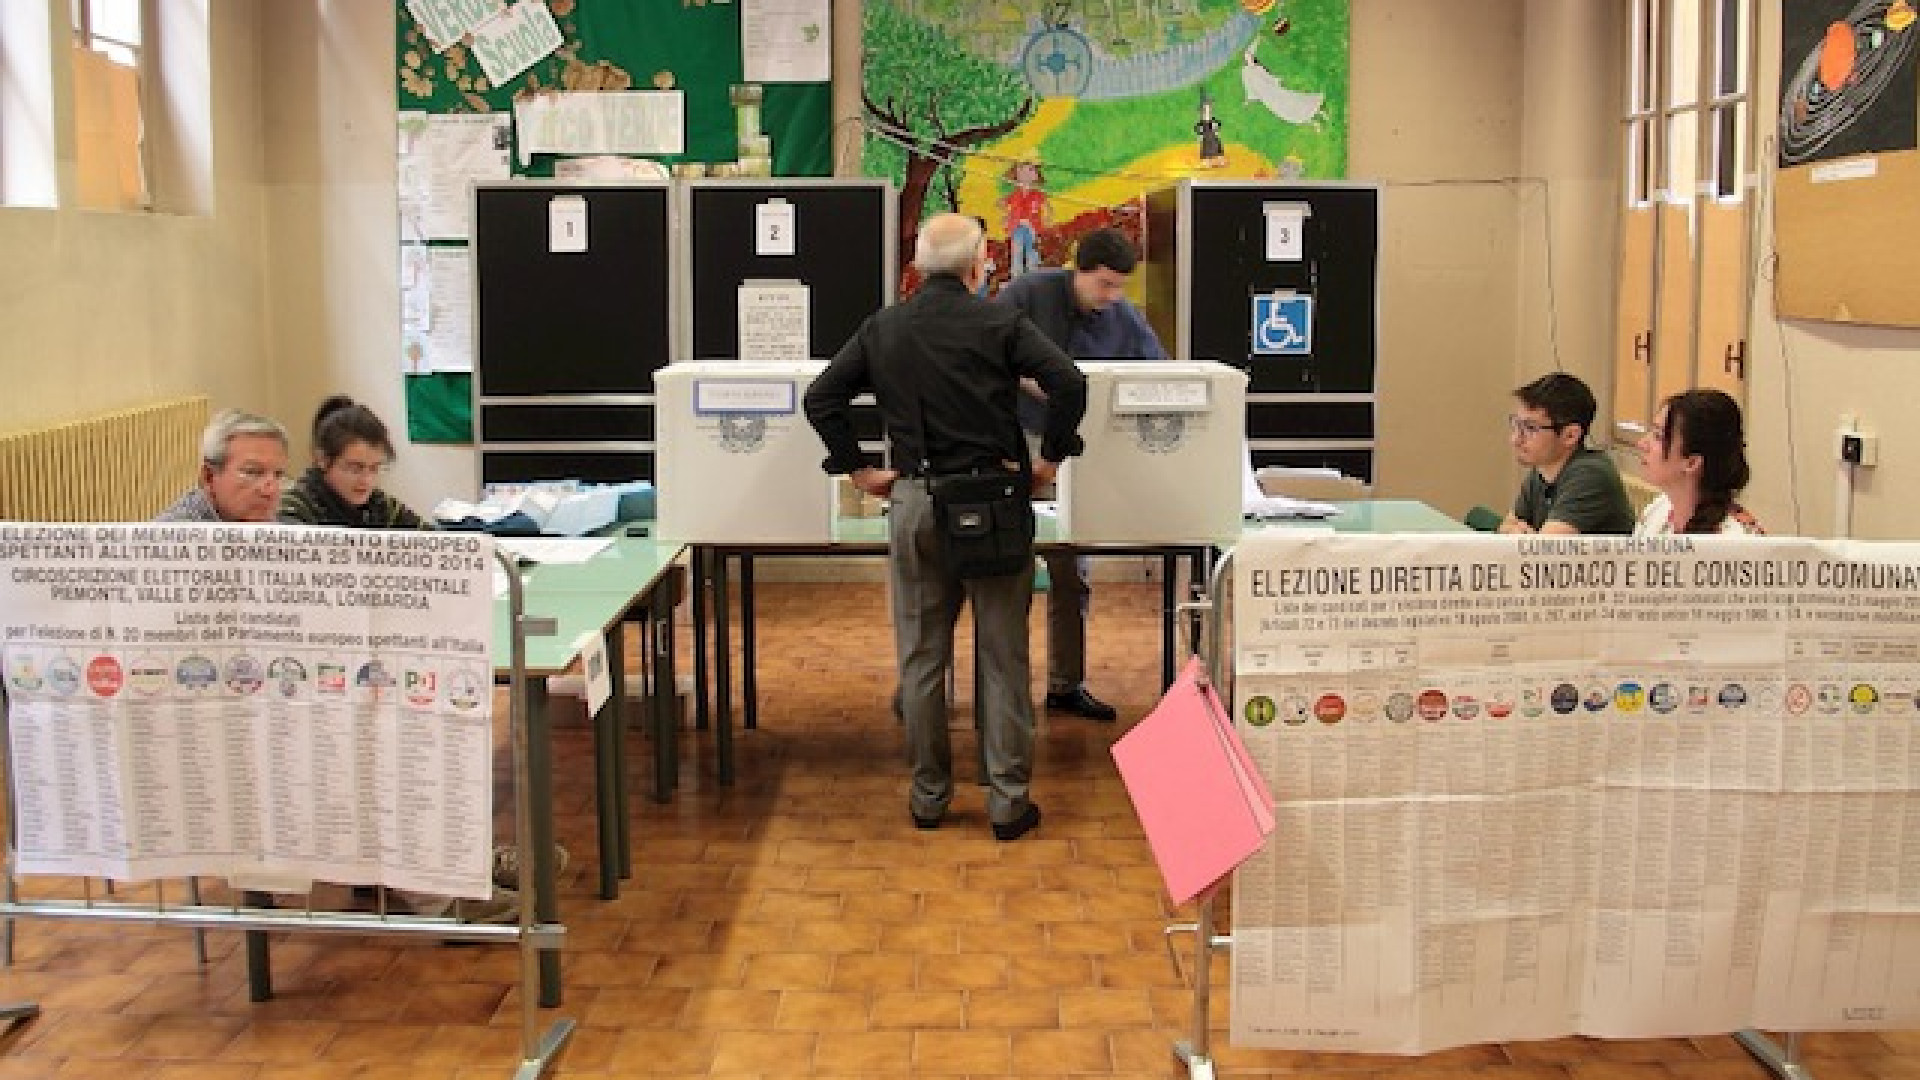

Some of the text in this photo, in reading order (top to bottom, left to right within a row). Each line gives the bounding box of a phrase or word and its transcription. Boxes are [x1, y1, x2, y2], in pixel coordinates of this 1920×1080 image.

[475, 7, 559, 79] Scuola
[769, 224, 781, 241] 2
[1280, 227, 1291, 245] 3
[2, 527, 480, 553] ELEZIONE DEI MEMBRI DEL PARLAMENTO EUROPEO
[1518, 539, 1588, 556] COMUNE
[99, 545, 190, 560] ALL'ITALIA
[197, 545, 215, 560] DI
[222, 546, 322, 564] DOMENICA
[329, 549, 351, 564] 25
[357, 551, 433, 568] MAGGIO
[438, 554, 484, 571] 2014
[12, 568, 137, 584] CIRCOSCRIZIONE
[143, 569, 243, 585] ELETTORALE
[259, 570, 306, 586] ITALIA
[312, 573, 357, 589] NORD
[360, 575, 470, 595] OCCIDENTALE
[1252, 559, 1920, 597] ELEZIONE DIRETTA DEL SINDACO E DEL CONSIGLIO COMUNA
[51, 586, 133, 604] PIEMONTE,
[138, 587, 183, 603] VALLE
[337, 590, 430, 609] LOMBARDIA
